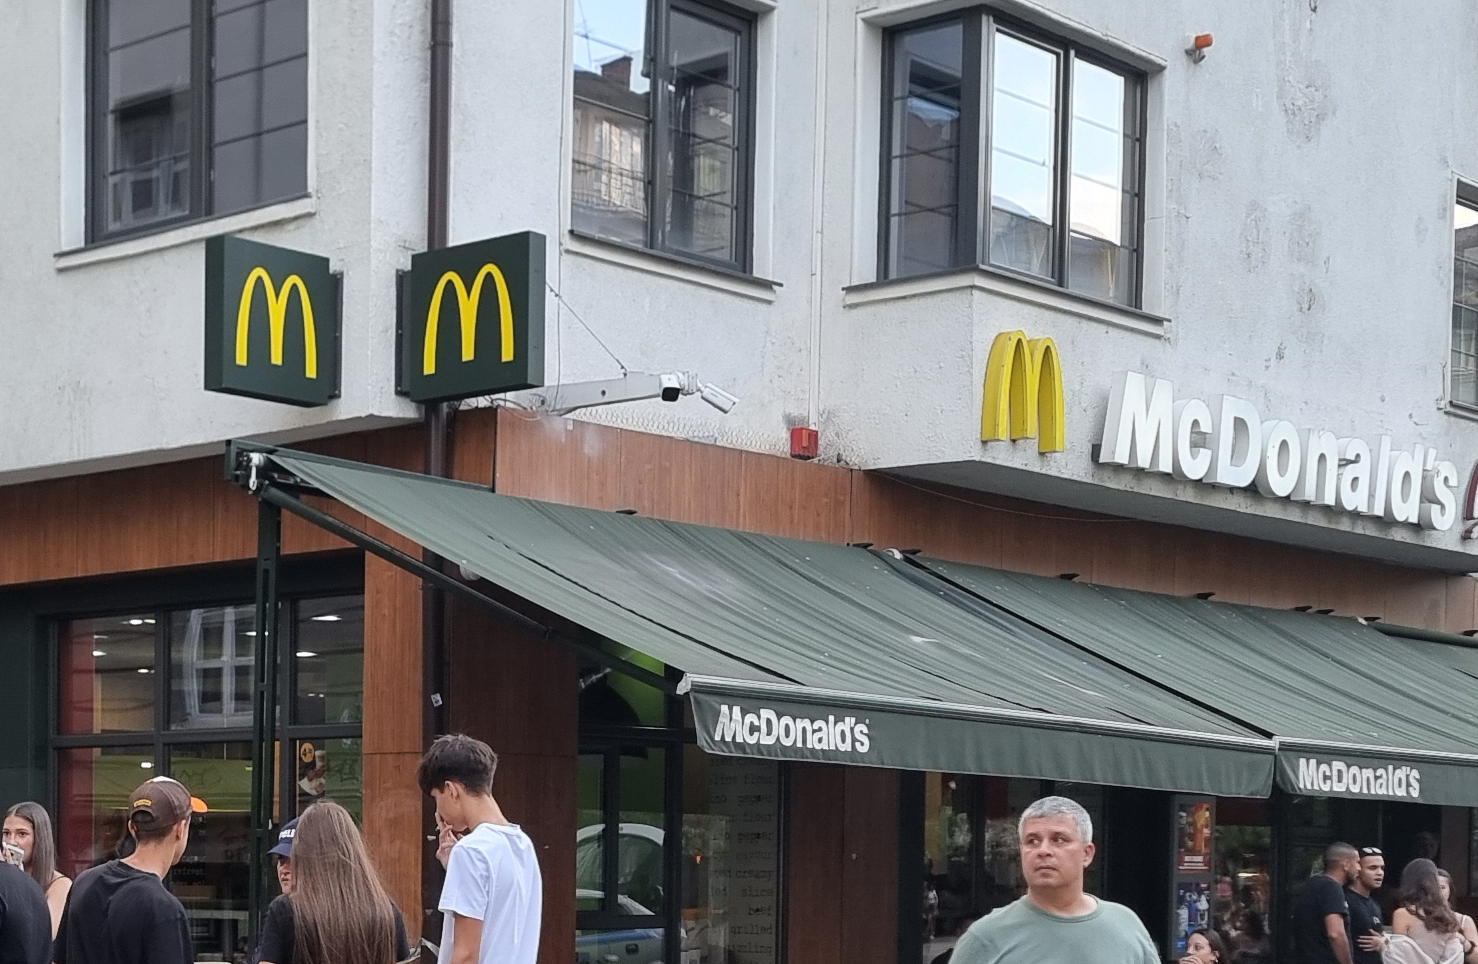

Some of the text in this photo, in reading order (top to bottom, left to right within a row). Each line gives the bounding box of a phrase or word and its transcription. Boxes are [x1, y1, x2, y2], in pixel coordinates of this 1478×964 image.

[1099, 370, 1459, 532] McDonald's
[714, 704, 871, 753] McDonald's
[1298, 757, 1421, 798] McDonald's
